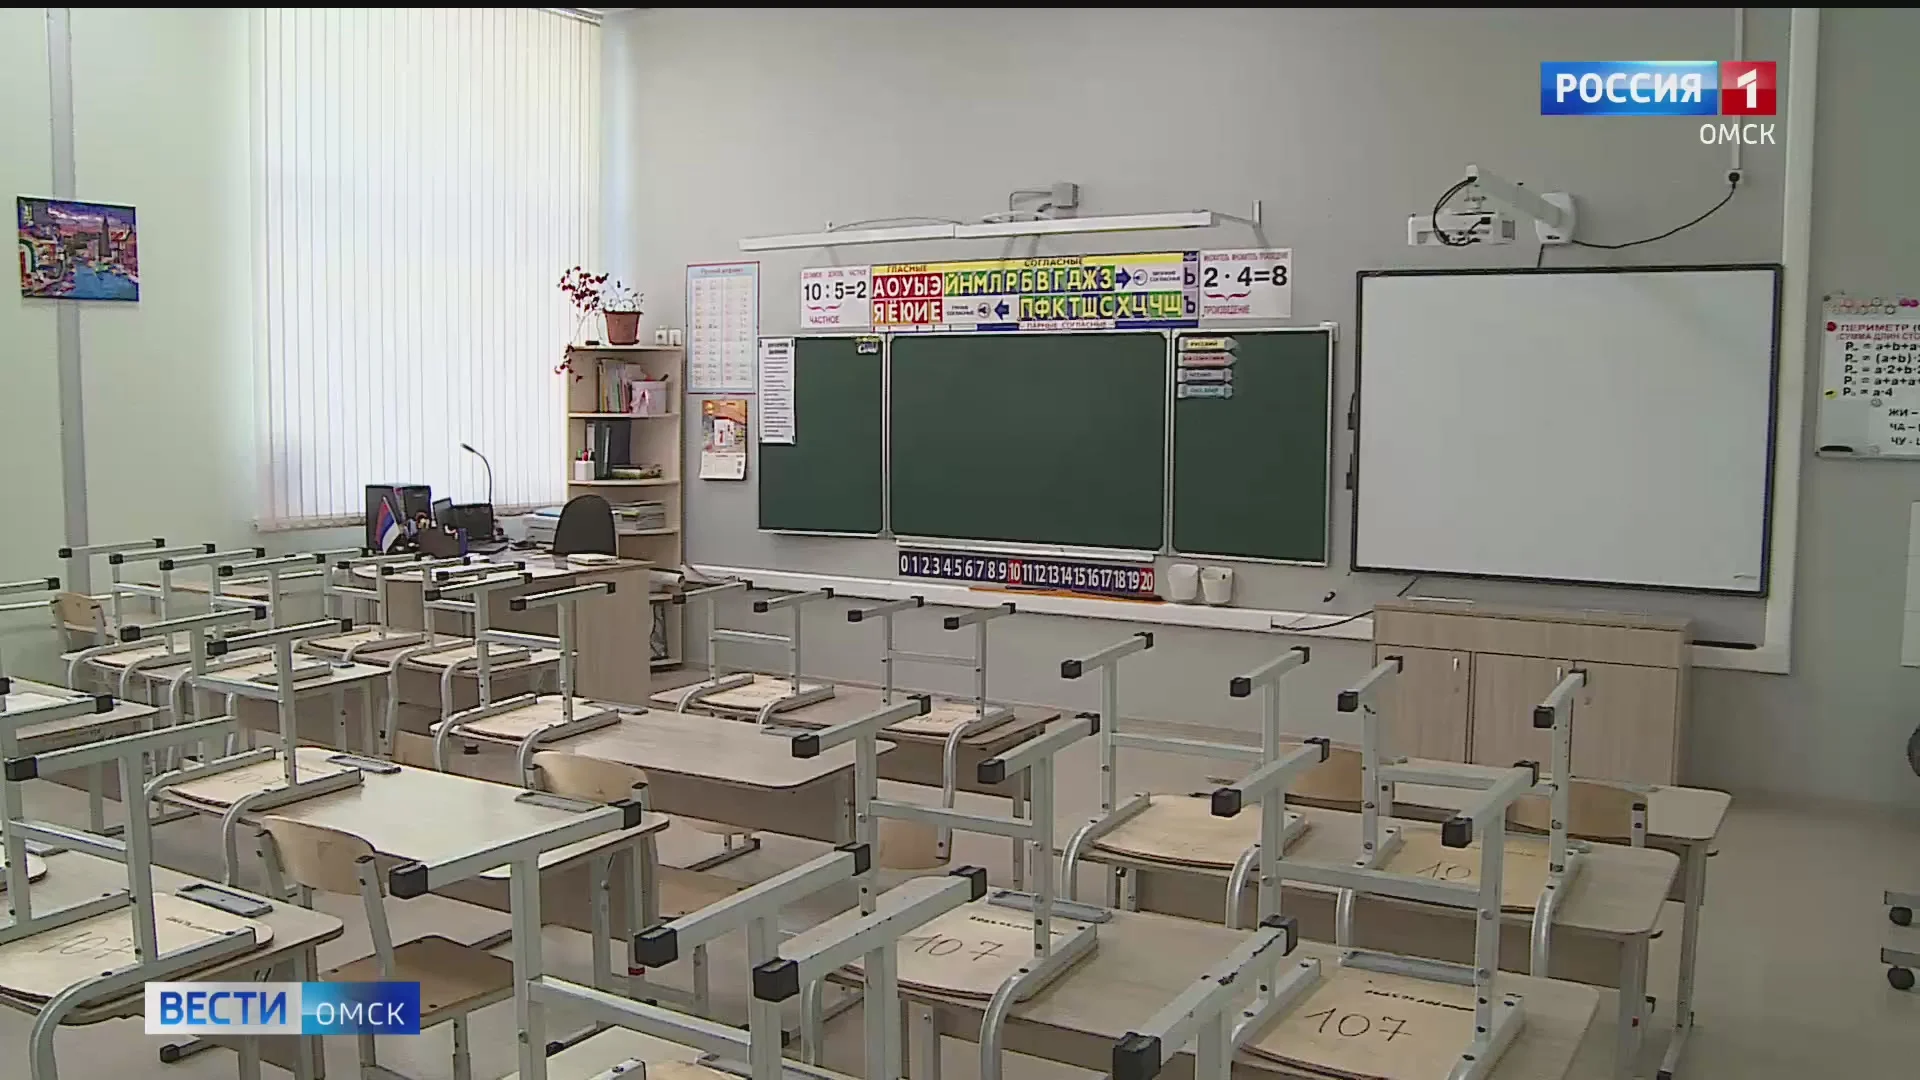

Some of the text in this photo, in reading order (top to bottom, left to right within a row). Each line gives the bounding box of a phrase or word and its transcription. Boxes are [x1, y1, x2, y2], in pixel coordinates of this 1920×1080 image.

[887, 265, 927, 273] ГЛАСНЫЕ
[1024, 258, 1083, 267] СОГЛАСНЫЕ
[1204, 267, 1218, 287] 2
[804, 283, 821, 301] 10
[1841, 324, 1909, 332] ПЕРИМЕТР
[1888, 408, 1908, 417] ЖИ
[1891, 437, 1907, 446] ЧУ
[900, 555, 1153, 591] 0 1 2 3 4 5 6 7 8 9 10 11 12 13 14 15 16 17 18 19 20
[896, 933, 1005, 961] 107
[1304, 1008, 1413, 1042] 107
